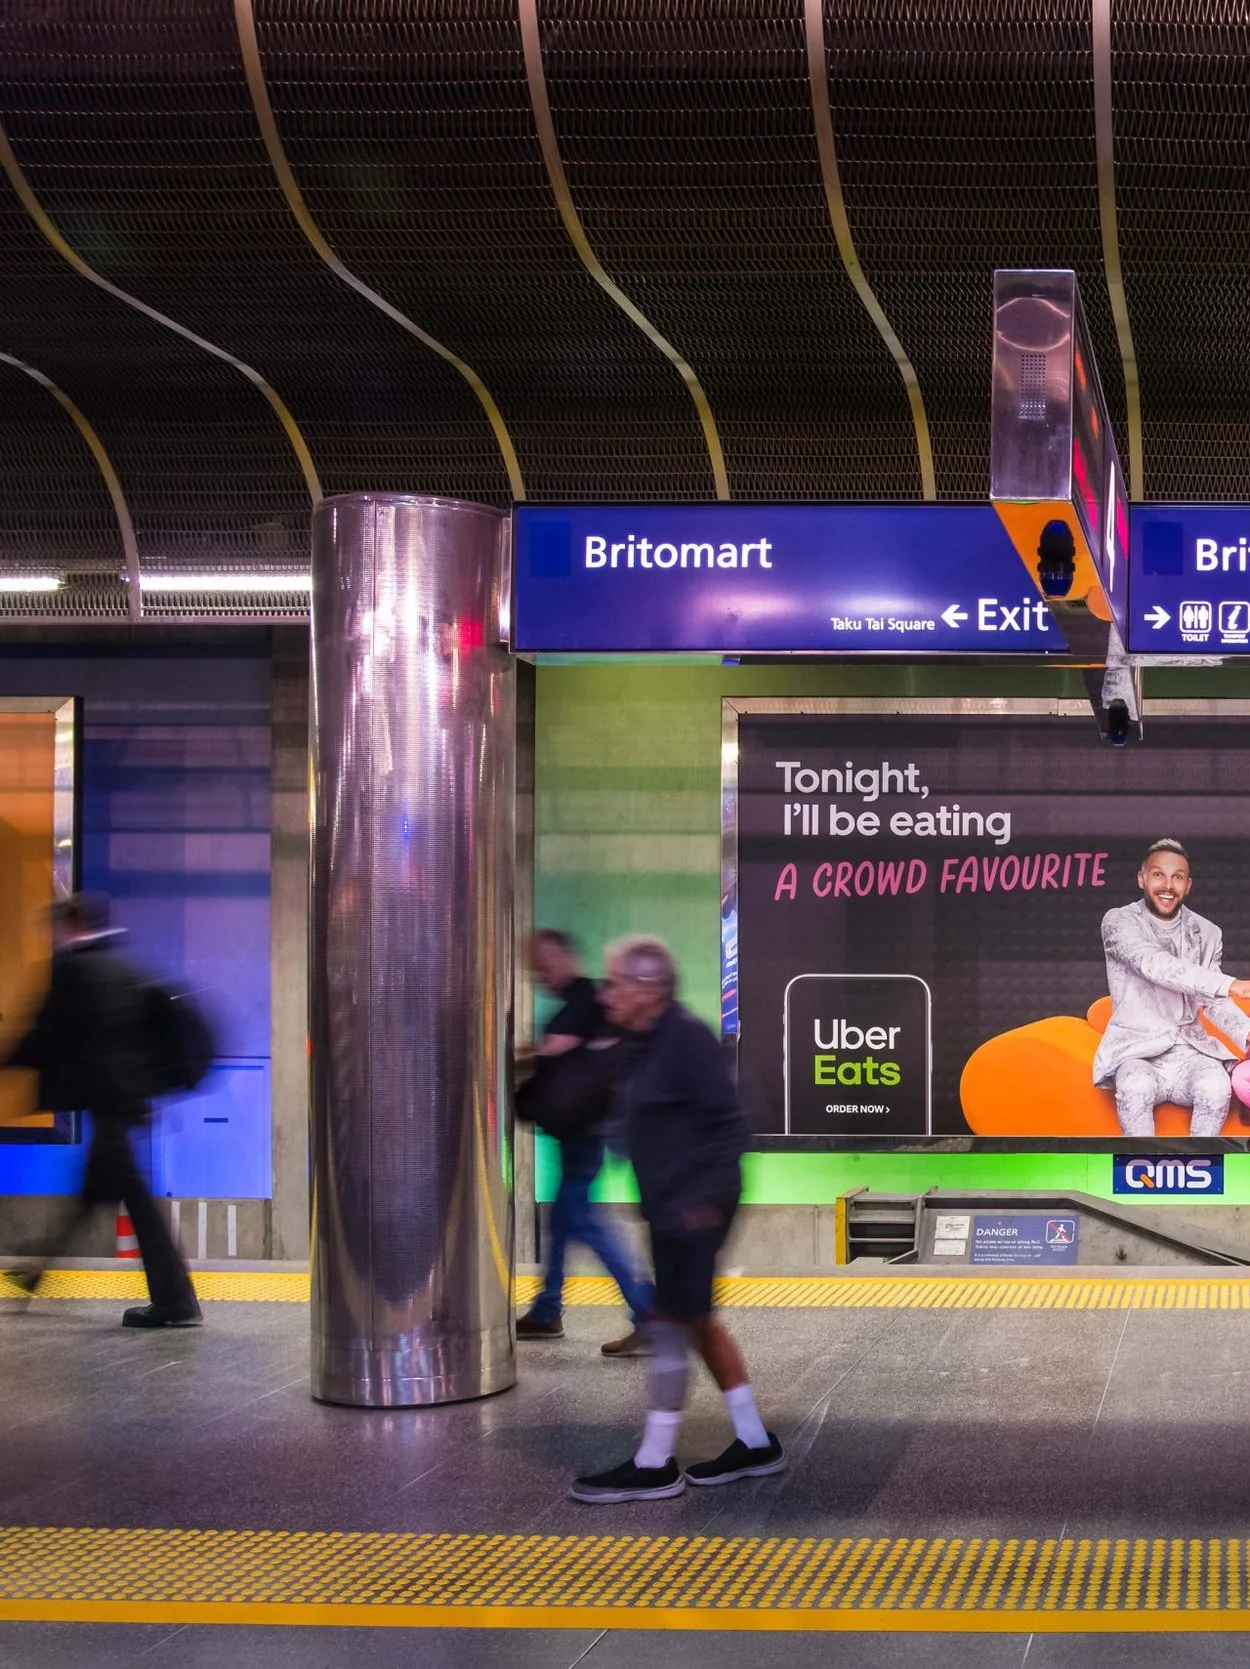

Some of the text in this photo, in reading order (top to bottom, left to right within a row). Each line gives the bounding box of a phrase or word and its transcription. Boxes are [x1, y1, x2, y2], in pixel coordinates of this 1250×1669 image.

[585, 535, 773, 569] Britomart
[830, 597, 1049, 633] Taku Tai Square Exit
[1182, 633, 1210, 642] TOILET
[775, 761, 929, 802] Tonight,
[784, 803, 1011, 845] I’ll be eating
[774, 852, 1109, 901] A CROWD FAVOURITE
[814, 1018, 901, 1050] Uber
[814, 1054, 901, 1086] Eats
[825, 1104, 885, 1114] ORDER NOW
[1125, 1159, 1212, 1189] QMS
[976, 1228, 1018, 1236] DANGER
